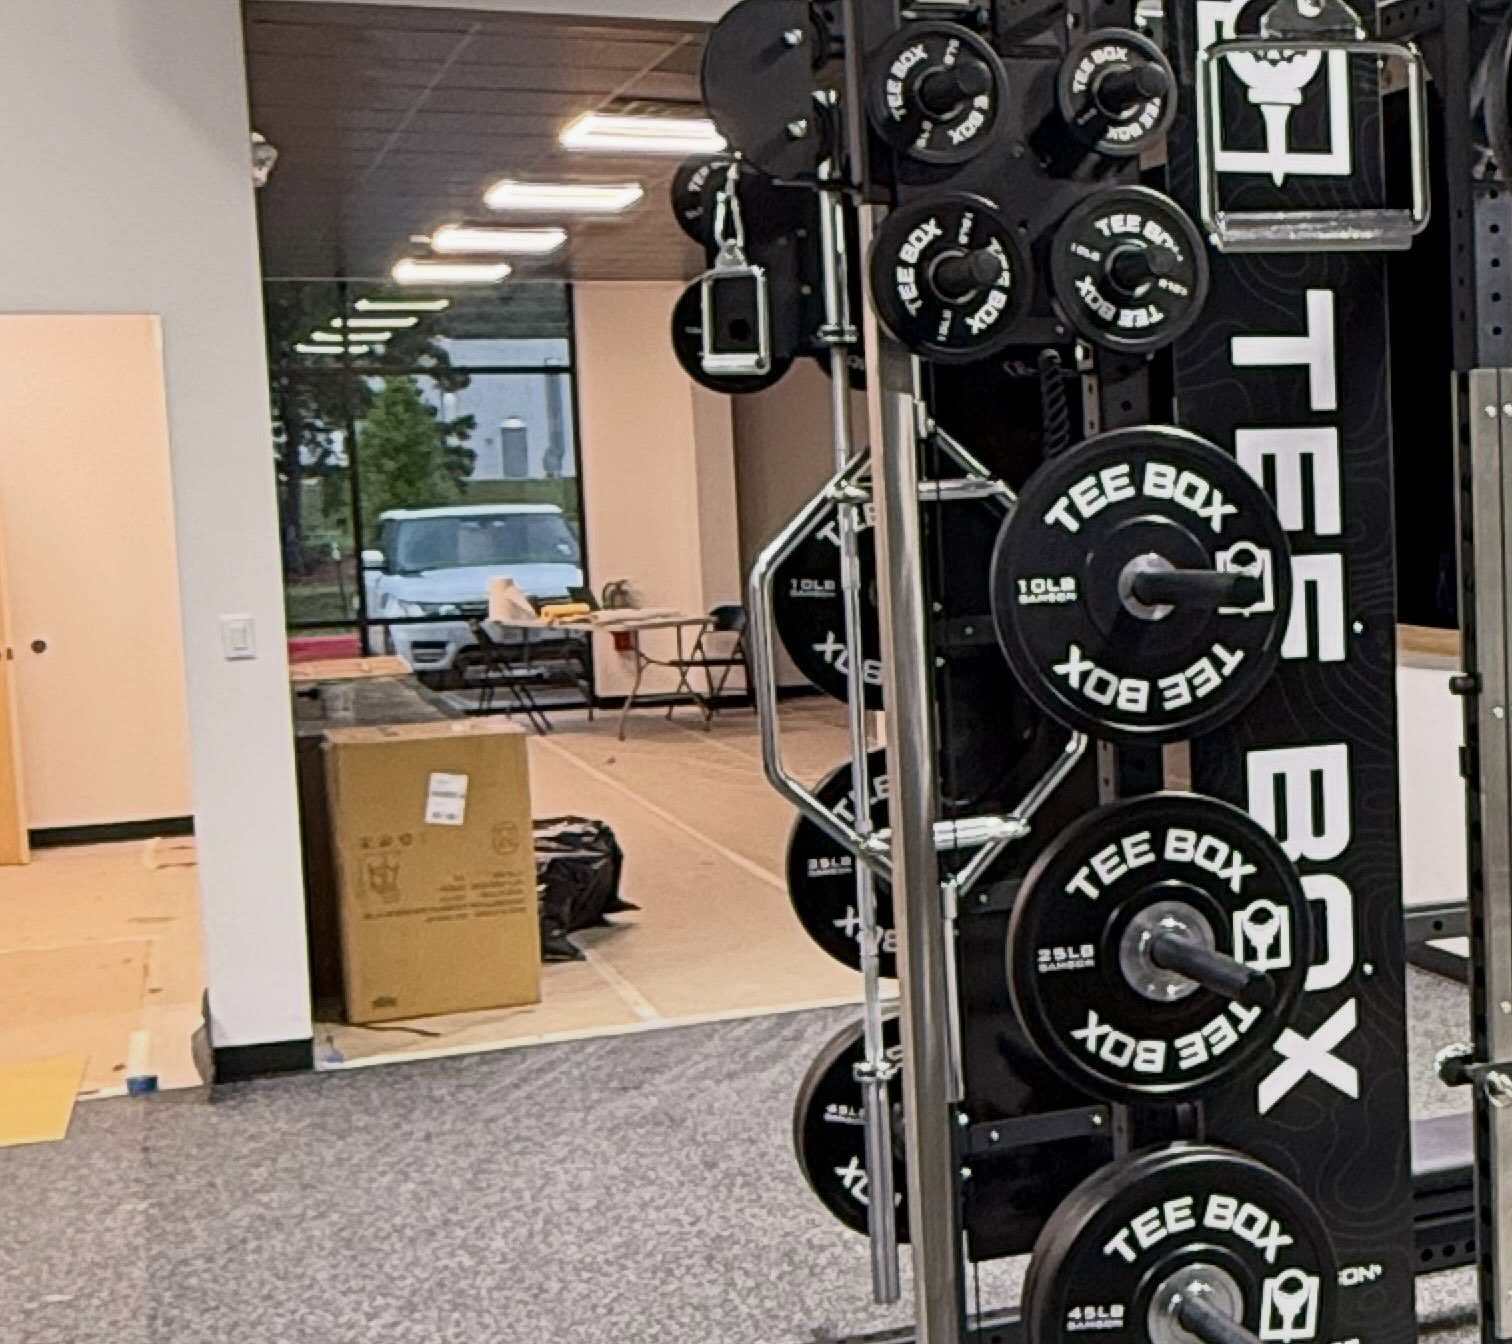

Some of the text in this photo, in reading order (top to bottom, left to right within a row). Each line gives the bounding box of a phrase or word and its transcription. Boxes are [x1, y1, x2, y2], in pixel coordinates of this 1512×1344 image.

[887, 44, 928, 121] TEE BOX
[1073, 46, 1128, 93] TEE BOX
[947, 110, 984, 145] BOX
[1107, 122, 1143, 141] BOX
[1095, 214, 1141, 237] TEE
[897, 218, 943, 317] TEE BOX
[965, 289, 1007, 335] BOX
[1075, 275, 1164, 328] TEE BOX
[1044, 462, 1238, 534] TEE BOX
[1017, 576, 1076, 594] 10LB
[1052, 643, 1245, 713] TEE BOX
[1064, 827, 1257, 900] TEE BOX
[1037, 944, 1095, 962] 25LB
[1070, 1000, 1261, 1073] TEE BOX
[1103, 1194, 1293, 1263] TEE BOX
